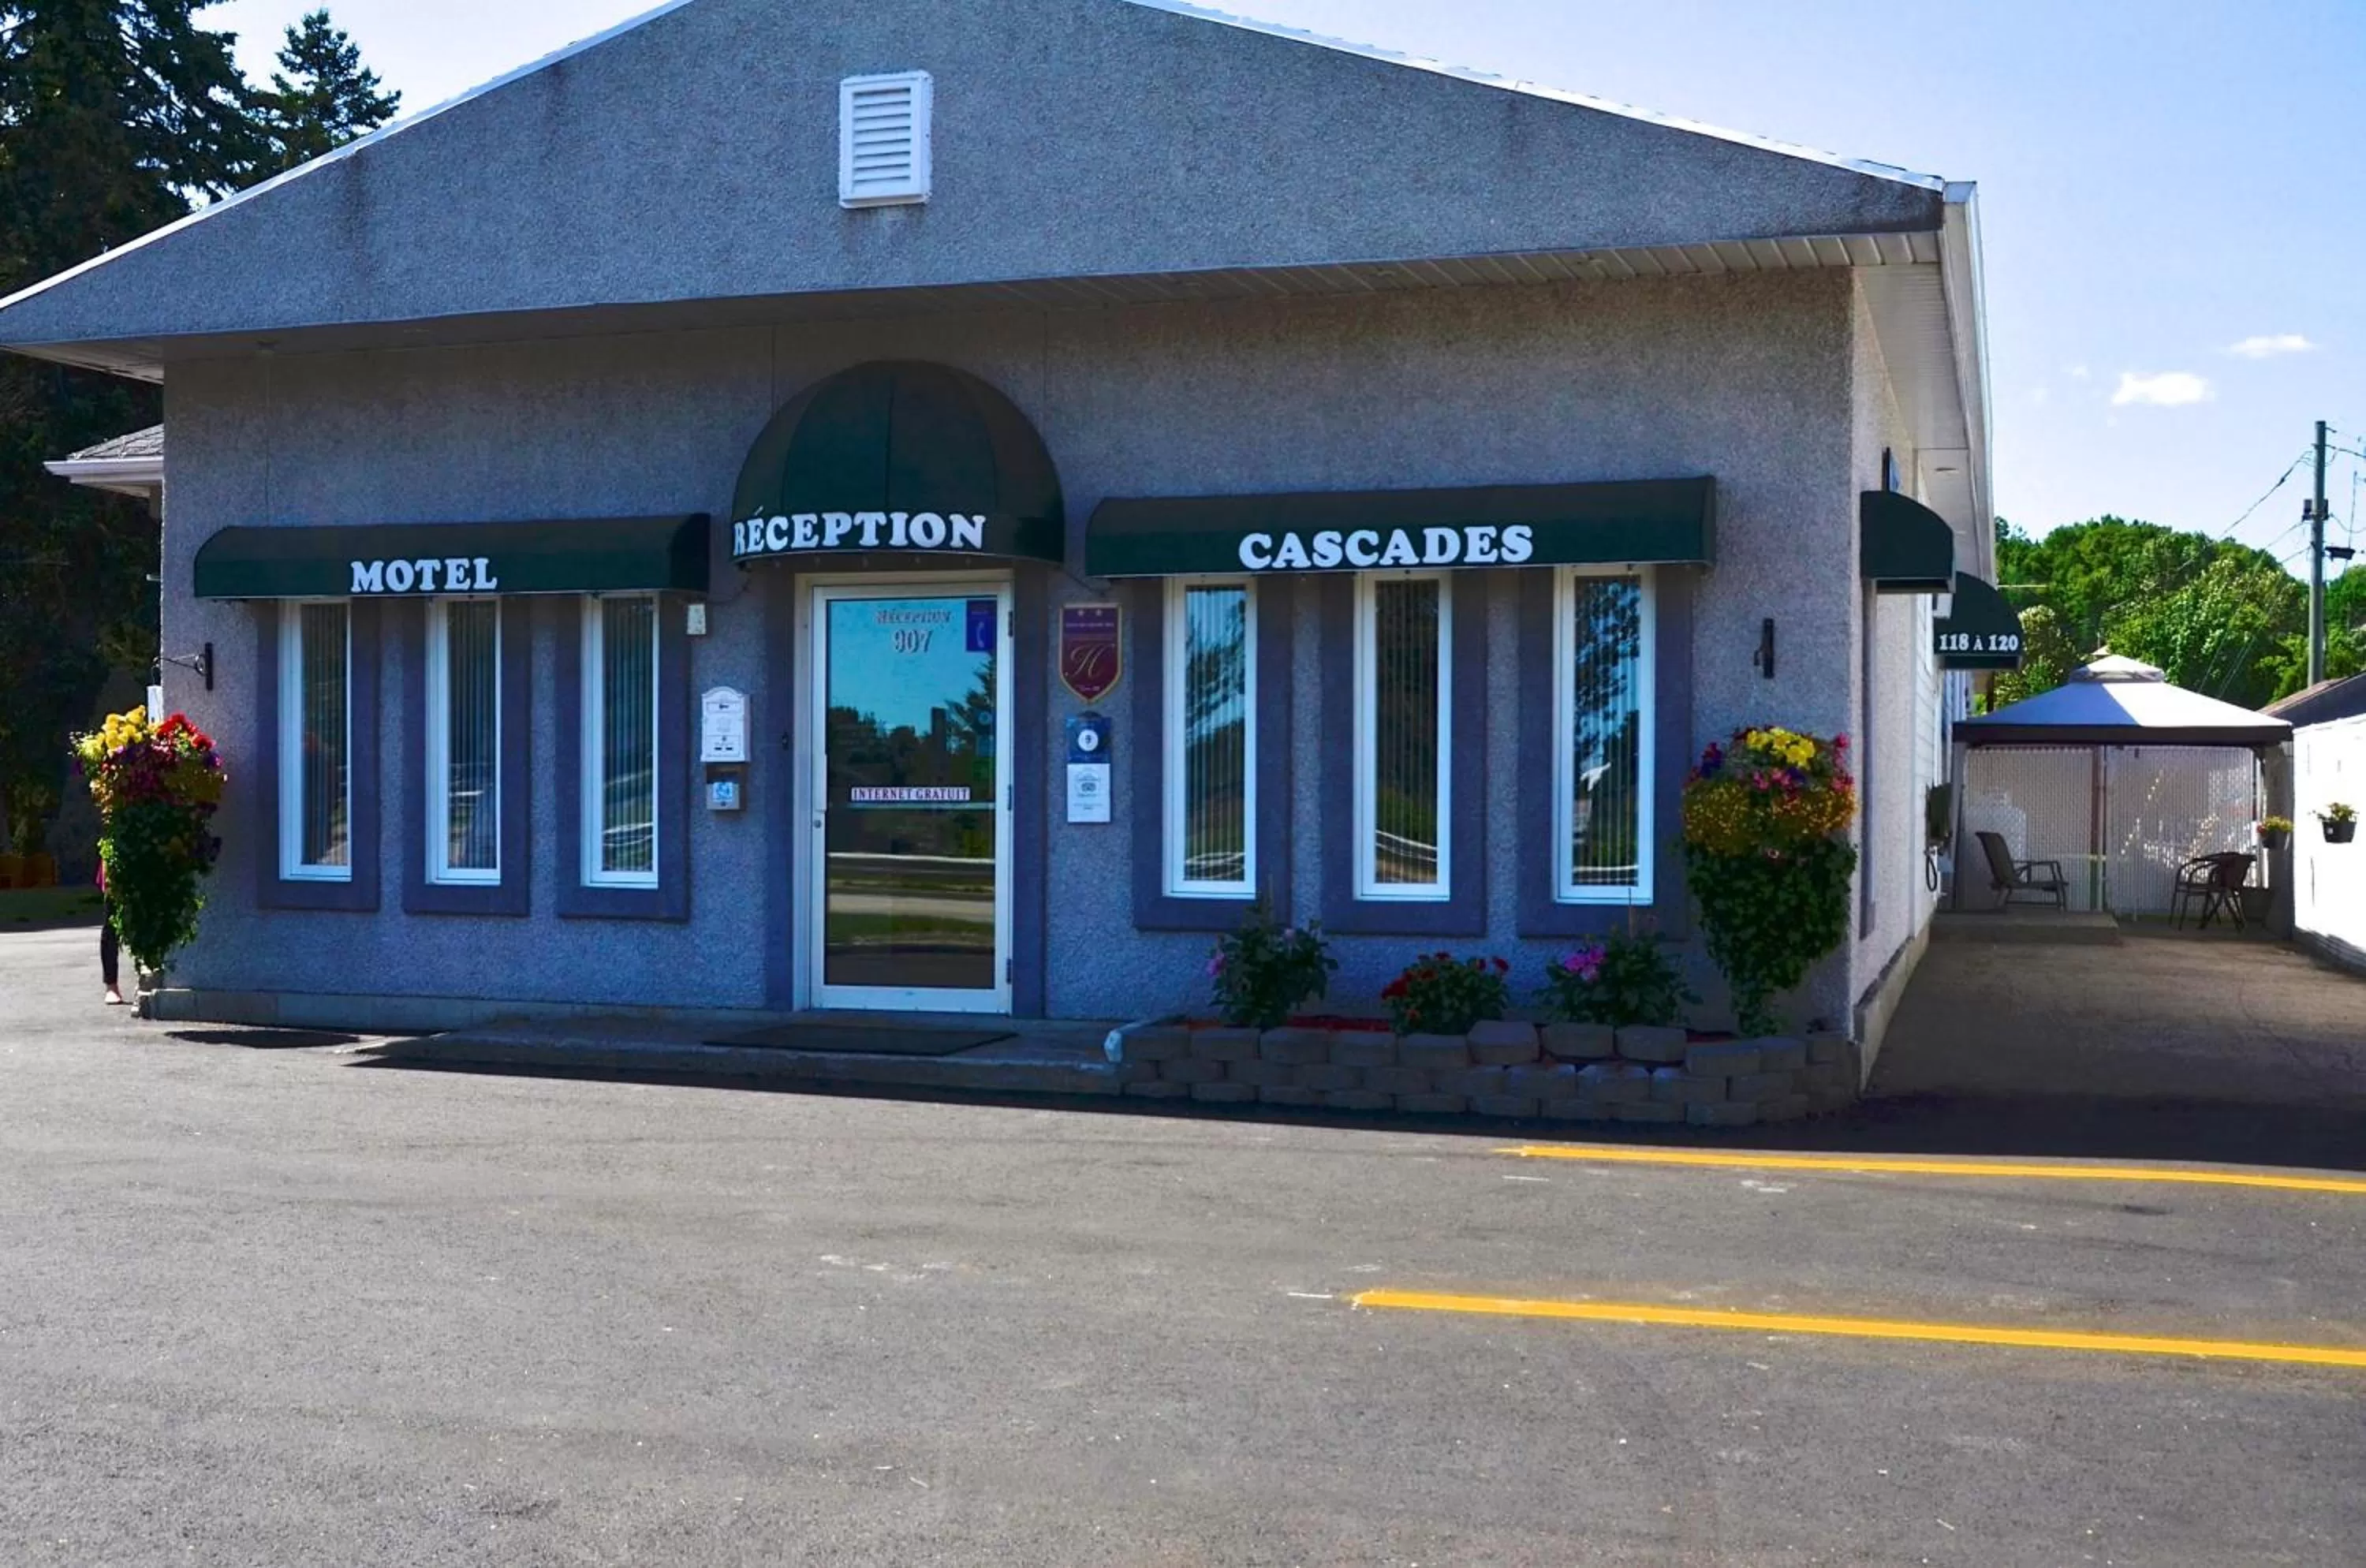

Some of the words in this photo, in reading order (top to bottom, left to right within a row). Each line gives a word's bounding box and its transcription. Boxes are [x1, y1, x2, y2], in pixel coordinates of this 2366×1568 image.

[733, 506, 986, 556] RÉCEPTION
[1238, 525, 1533, 569] CASCADES
[350, 557, 498, 592] MOTEL
[1939, 633, 1969, 651] 118
[1988, 634, 2018, 651] 120
[853, 788, 912, 801] INTERNET
[916, 788, 968, 801] GRATUIT
